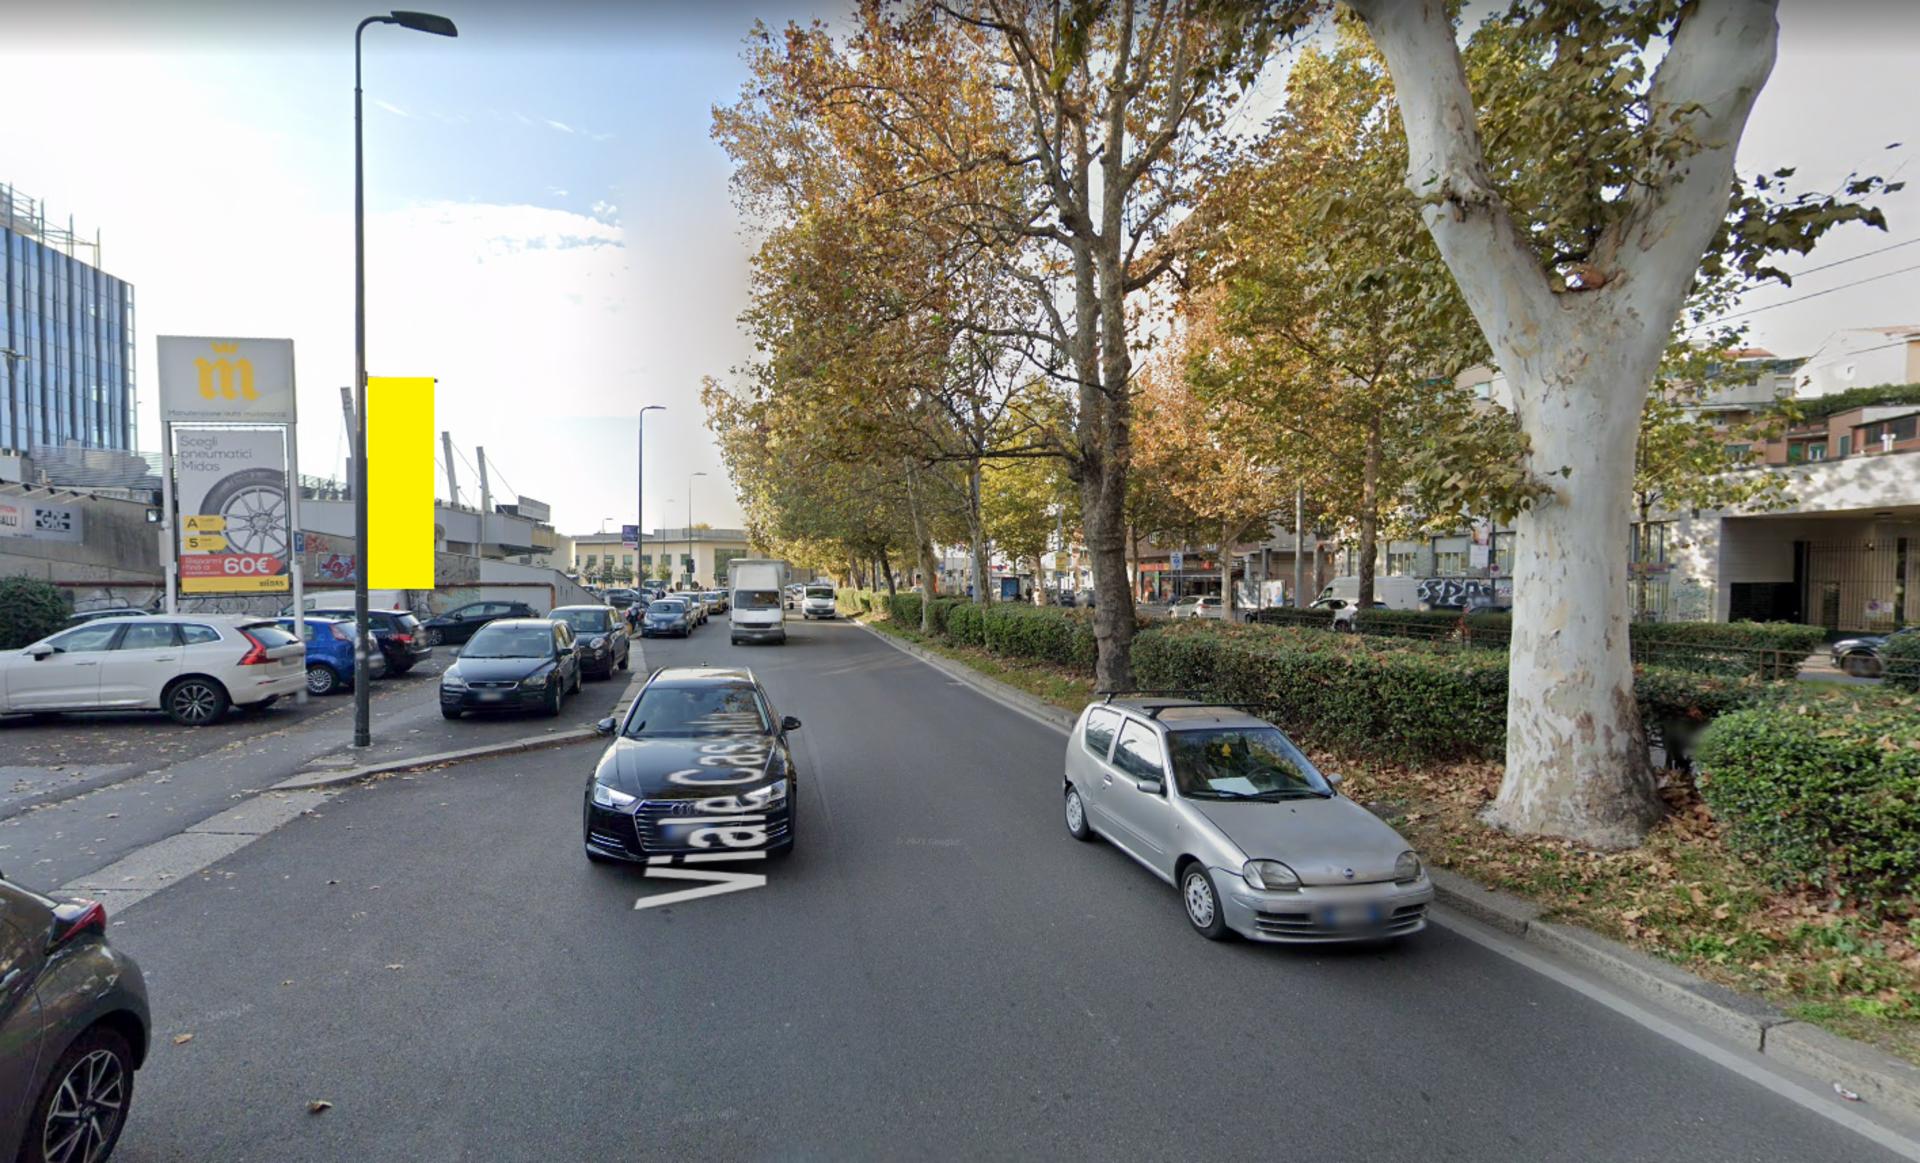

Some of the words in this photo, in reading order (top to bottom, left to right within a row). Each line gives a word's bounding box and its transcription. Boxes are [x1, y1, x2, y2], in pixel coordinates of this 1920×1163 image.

[180, 435, 218, 450] Scegli
[181, 449, 252, 460] pneumatici
[182, 461, 220, 472] Midas
[187, 518, 198, 528] A
[189, 538, 199, 548] 5
